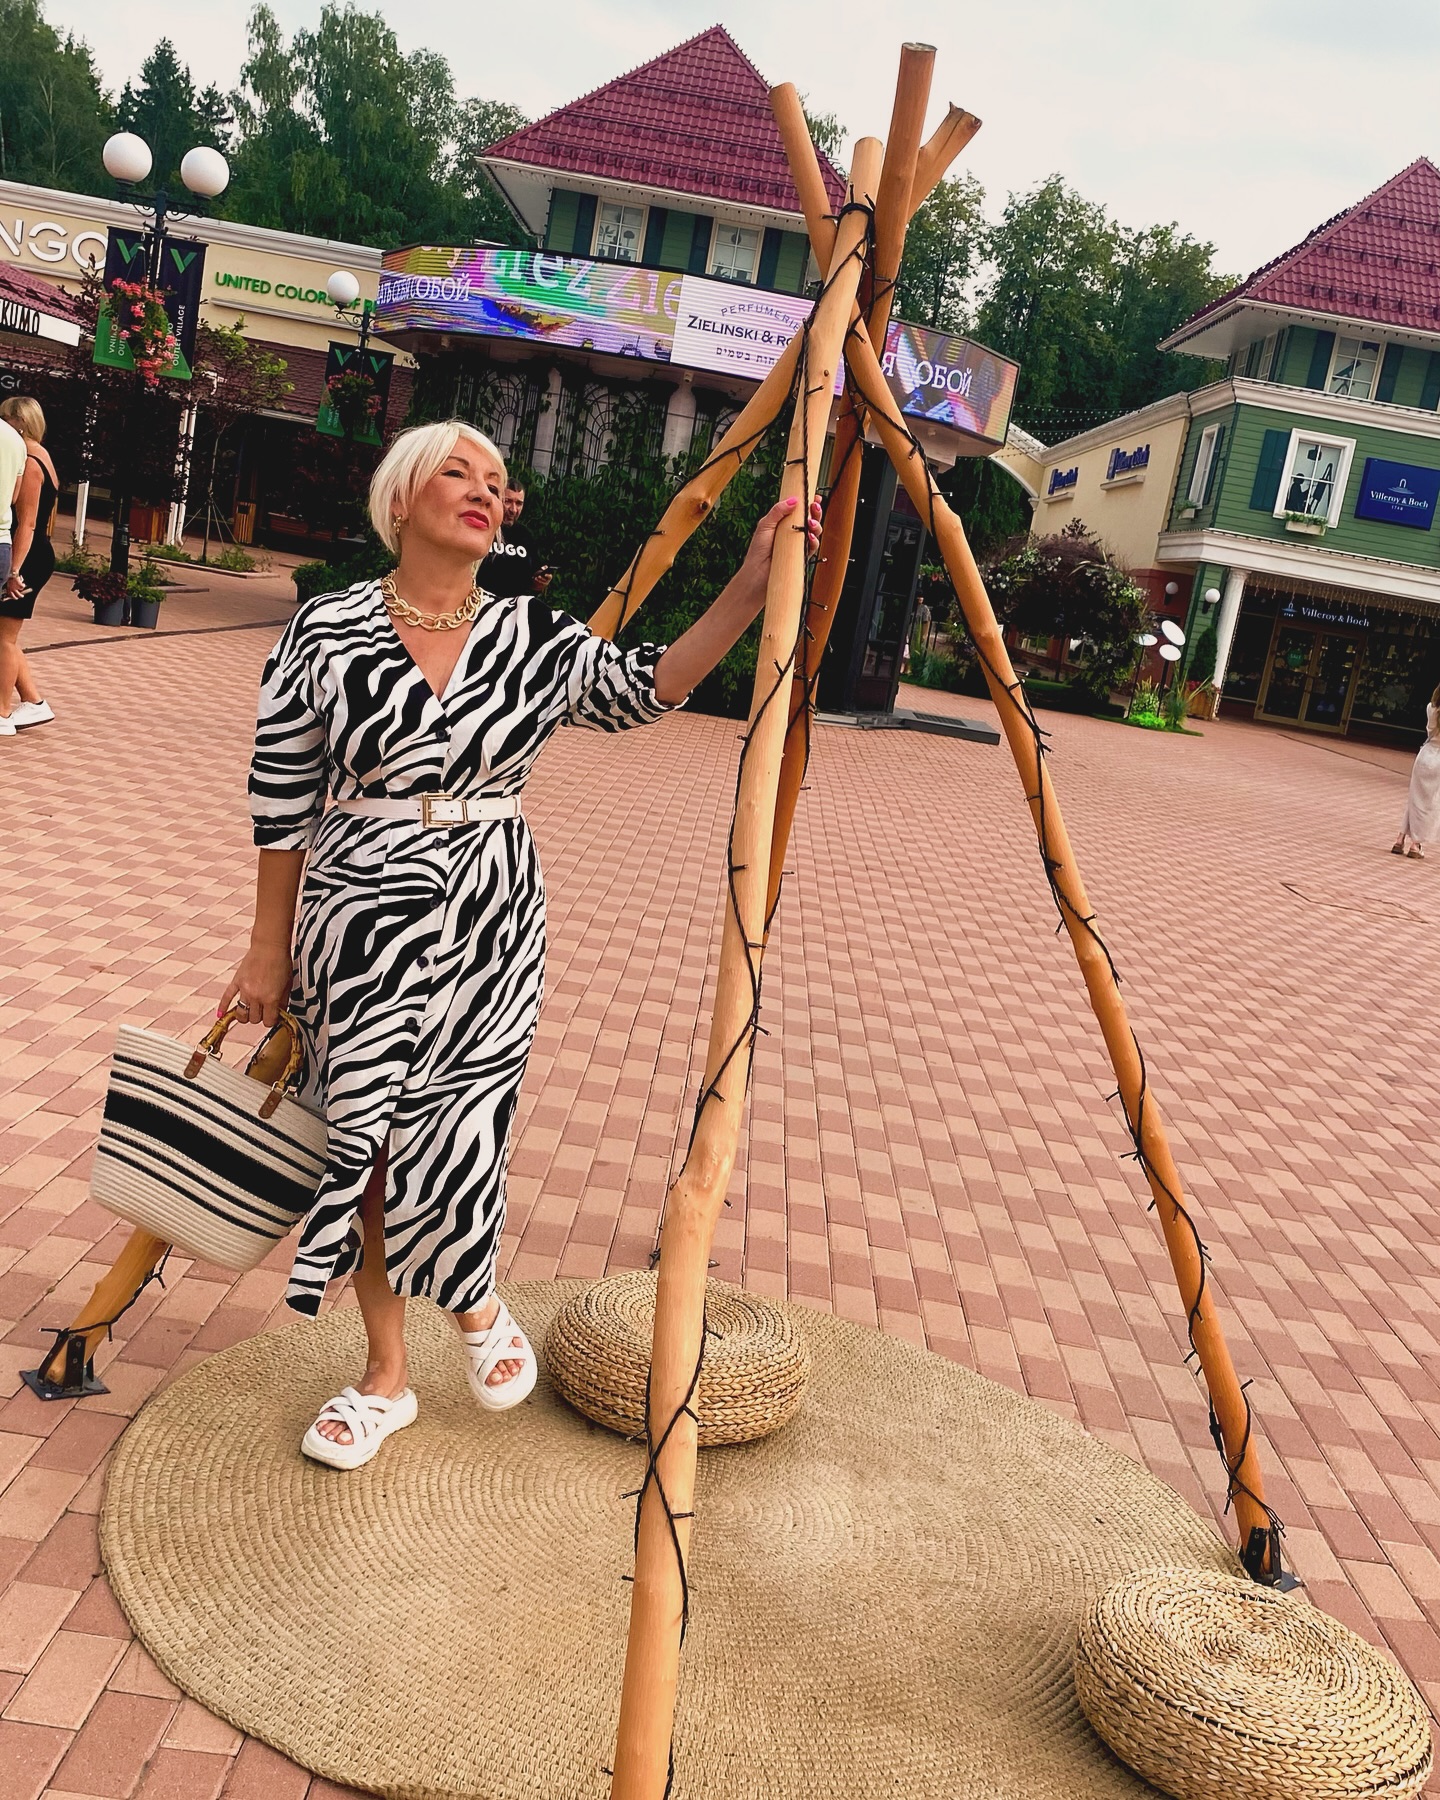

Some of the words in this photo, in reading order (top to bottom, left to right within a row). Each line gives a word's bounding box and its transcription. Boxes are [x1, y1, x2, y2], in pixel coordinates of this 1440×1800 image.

[215, 271, 271, 294] UNITED
[176, 304, 185, 336] VILLAGE
[687, 315, 758, 341] ZIELINSKI
[761, 330, 773, 344] &
[721, 303, 800, 333] PERFUMERIE
[913, 360, 972, 397] ОБОЙ
[1370, 490, 1401, 504] Villeroy
[1408, 497, 1429, 508] Boch
[1301, 606, 1337, 622] Villeroy
[1346, 615, 1370, 627] Boch
